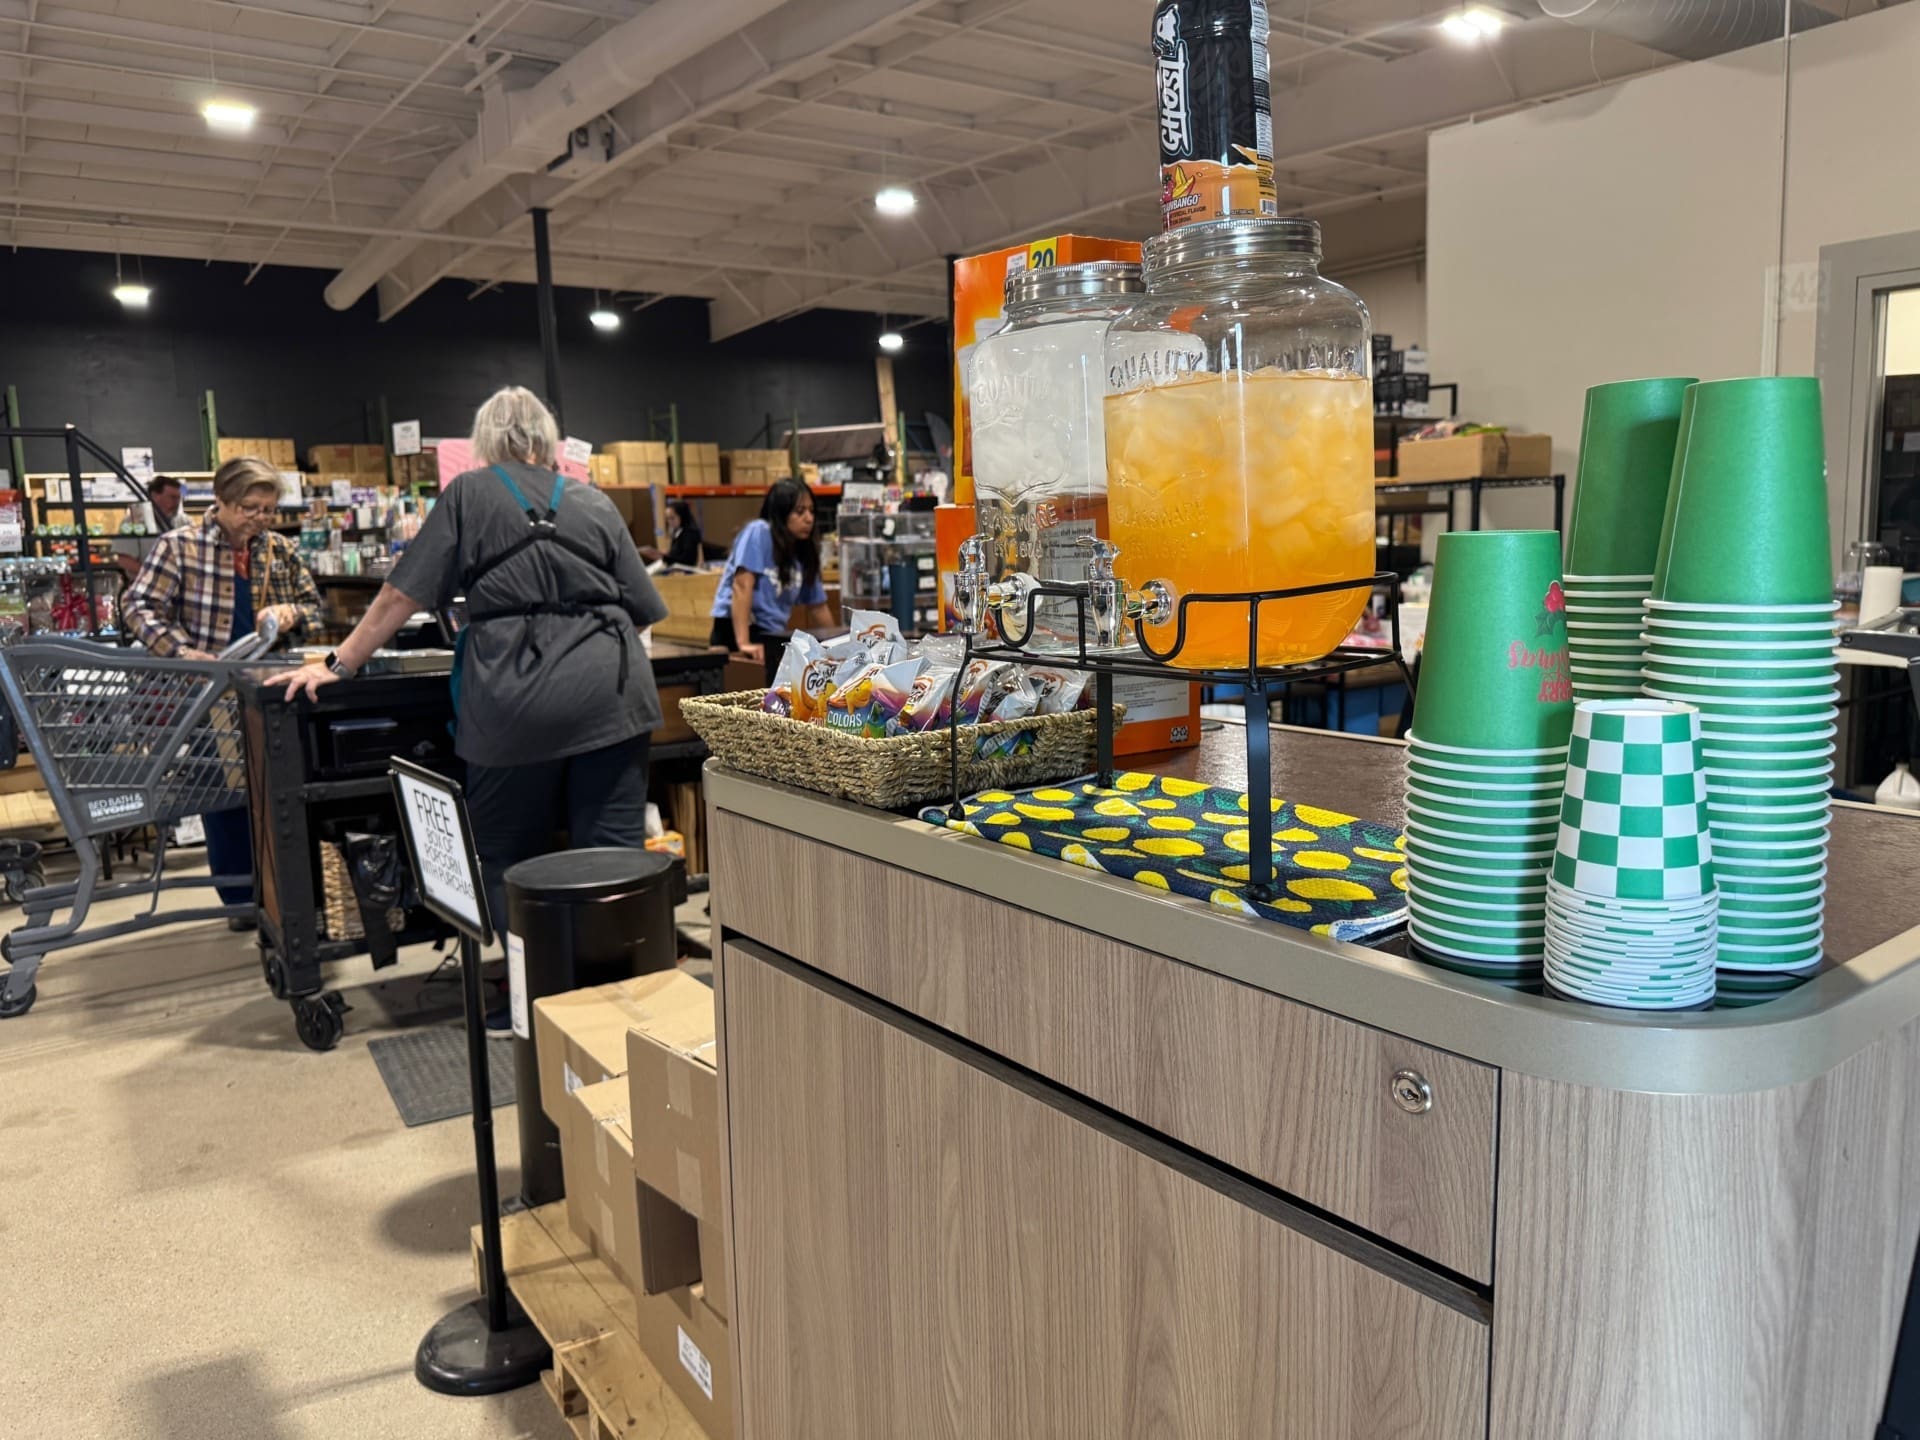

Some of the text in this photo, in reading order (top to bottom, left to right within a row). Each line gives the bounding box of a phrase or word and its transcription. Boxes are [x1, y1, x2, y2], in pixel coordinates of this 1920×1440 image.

[1158, 42, 1189, 152] GHOST
[1032, 248, 1053, 269] 20
[1109, 348, 1204, 388] QUALITY
[827, 711, 862, 728] COLORS
[88, 800, 107, 810] BED
[108, 794, 134, 806] BATH
[90, 801, 144, 817] BEYOND
[413, 788, 454, 838] FREE
[424, 843, 463, 877] POPCORN
[439, 866, 476, 900] PURCHAS
